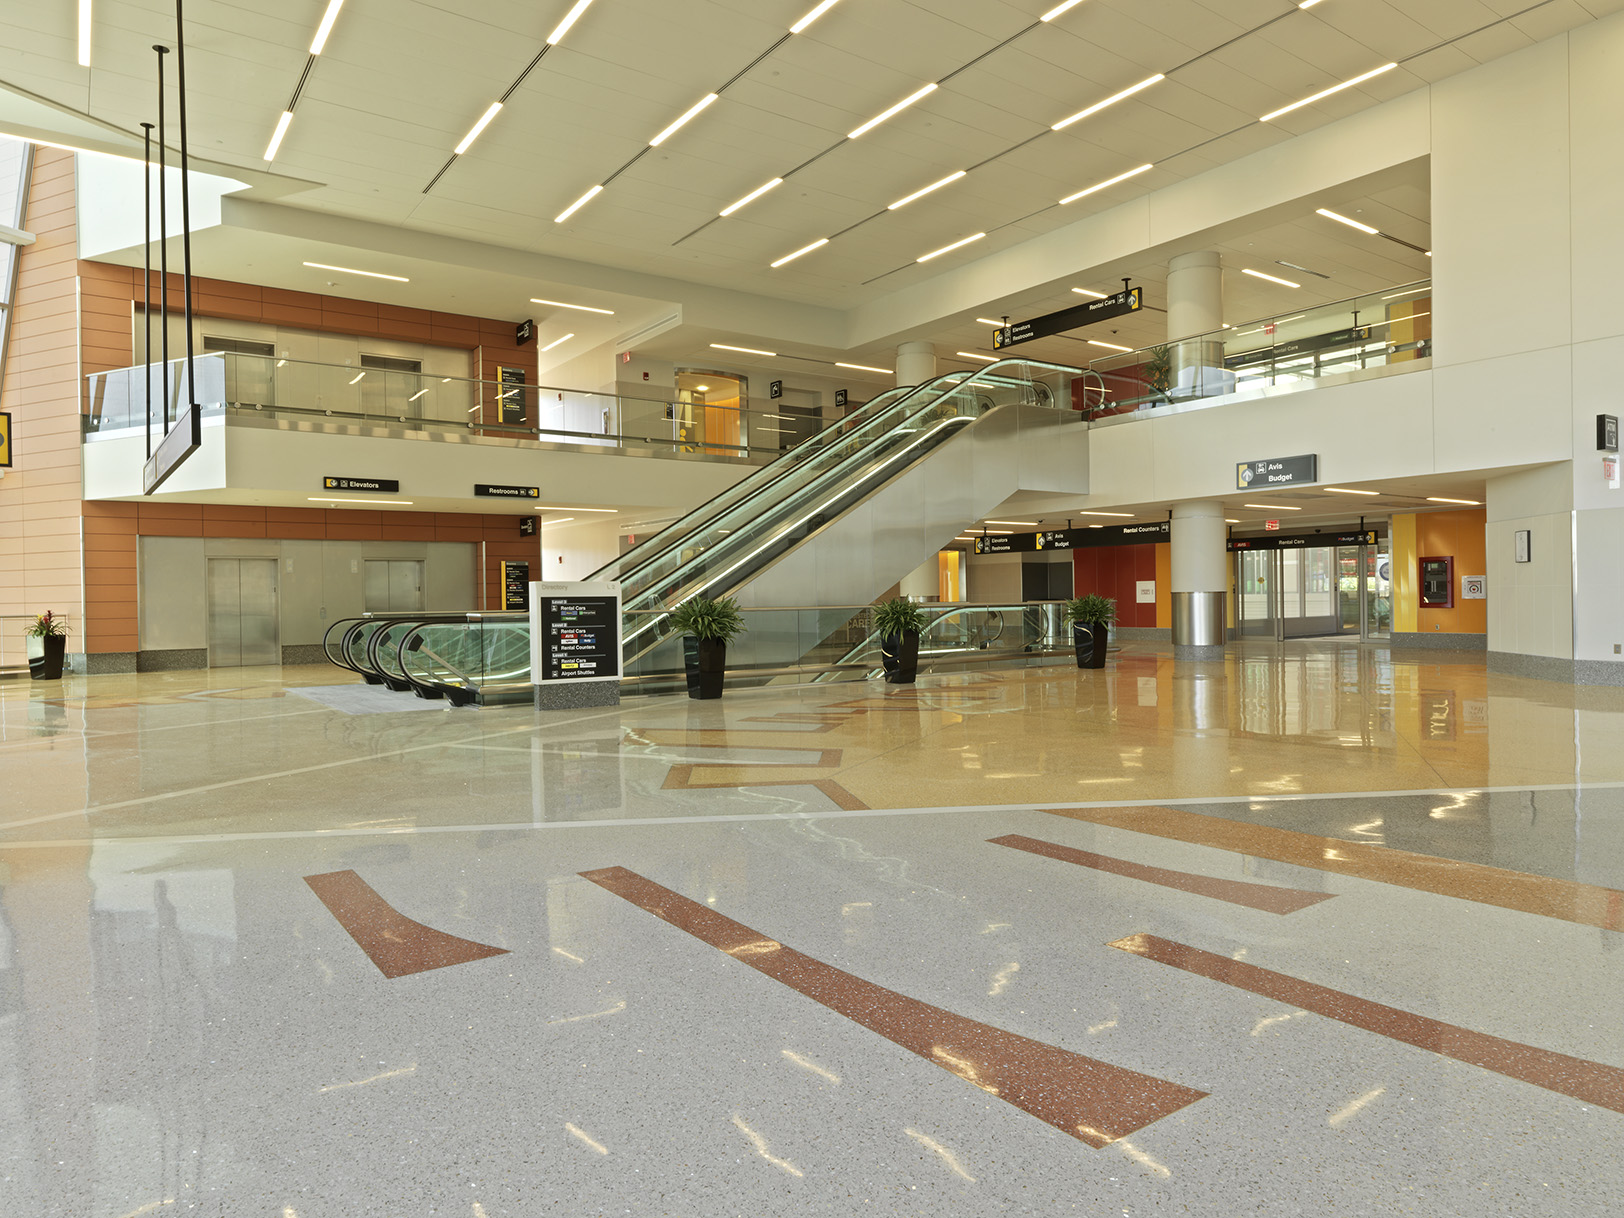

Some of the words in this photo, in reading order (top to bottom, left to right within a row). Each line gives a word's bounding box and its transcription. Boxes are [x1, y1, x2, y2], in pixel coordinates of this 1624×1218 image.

[1089, 301, 1104, 311] Rental
[1012, 324, 1031, 333] Elevators
[1012, 332, 1034, 342] Restrooms
[1268, 463, 1283, 471] Avis
[1268, 473, 1293, 482] Budget
[349, 481, 379, 489] Elevators
[488, 487, 519, 495] Restrooms
